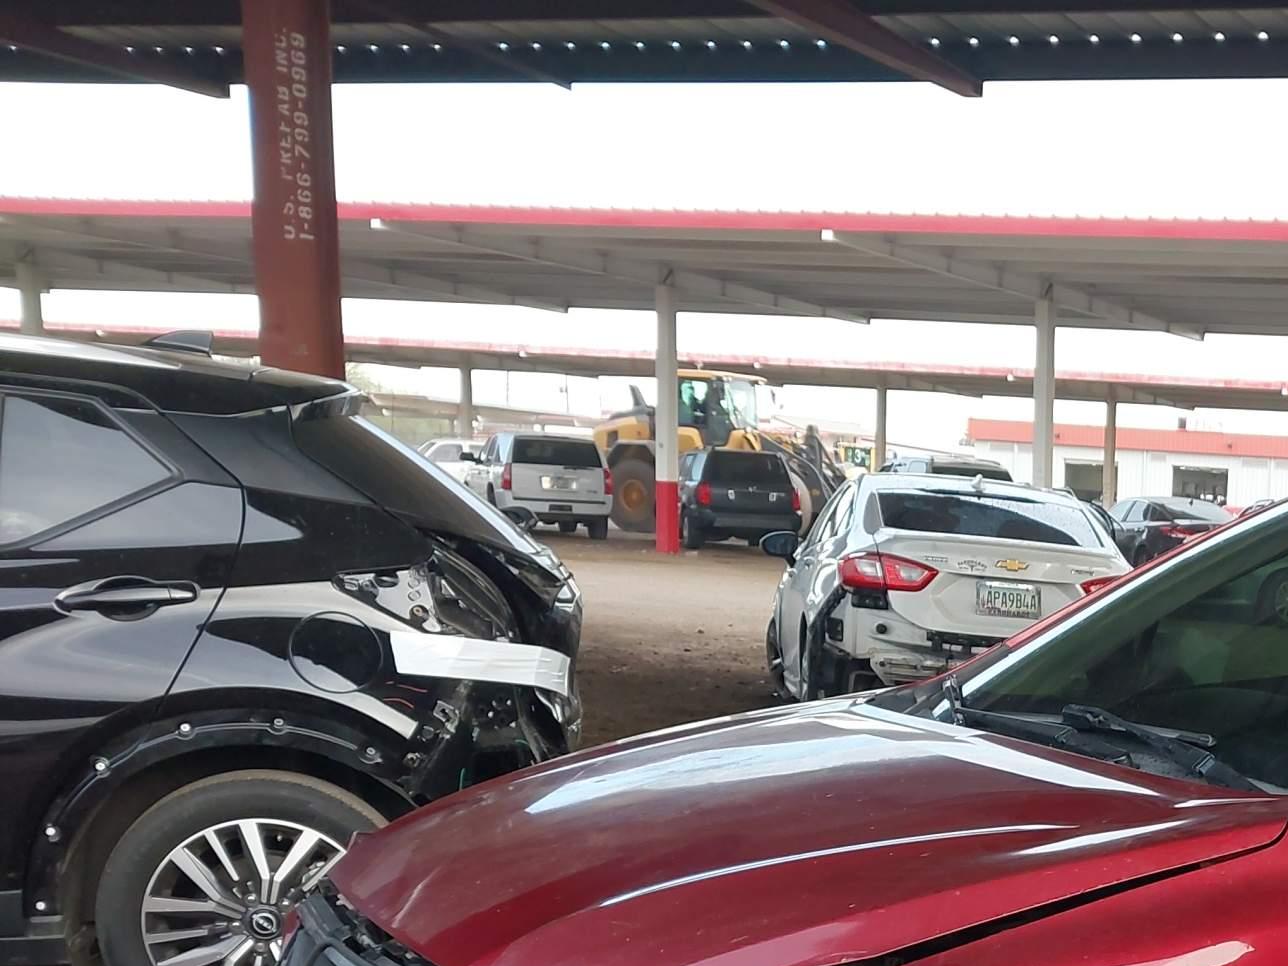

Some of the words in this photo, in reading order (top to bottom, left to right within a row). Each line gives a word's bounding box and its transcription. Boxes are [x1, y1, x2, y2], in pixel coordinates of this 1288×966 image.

[277, 87, 294, 181] PREFAB
[290, 33, 315, 241] 1-866-799-0969
[986, 590, 1037, 610] APA9B4A
